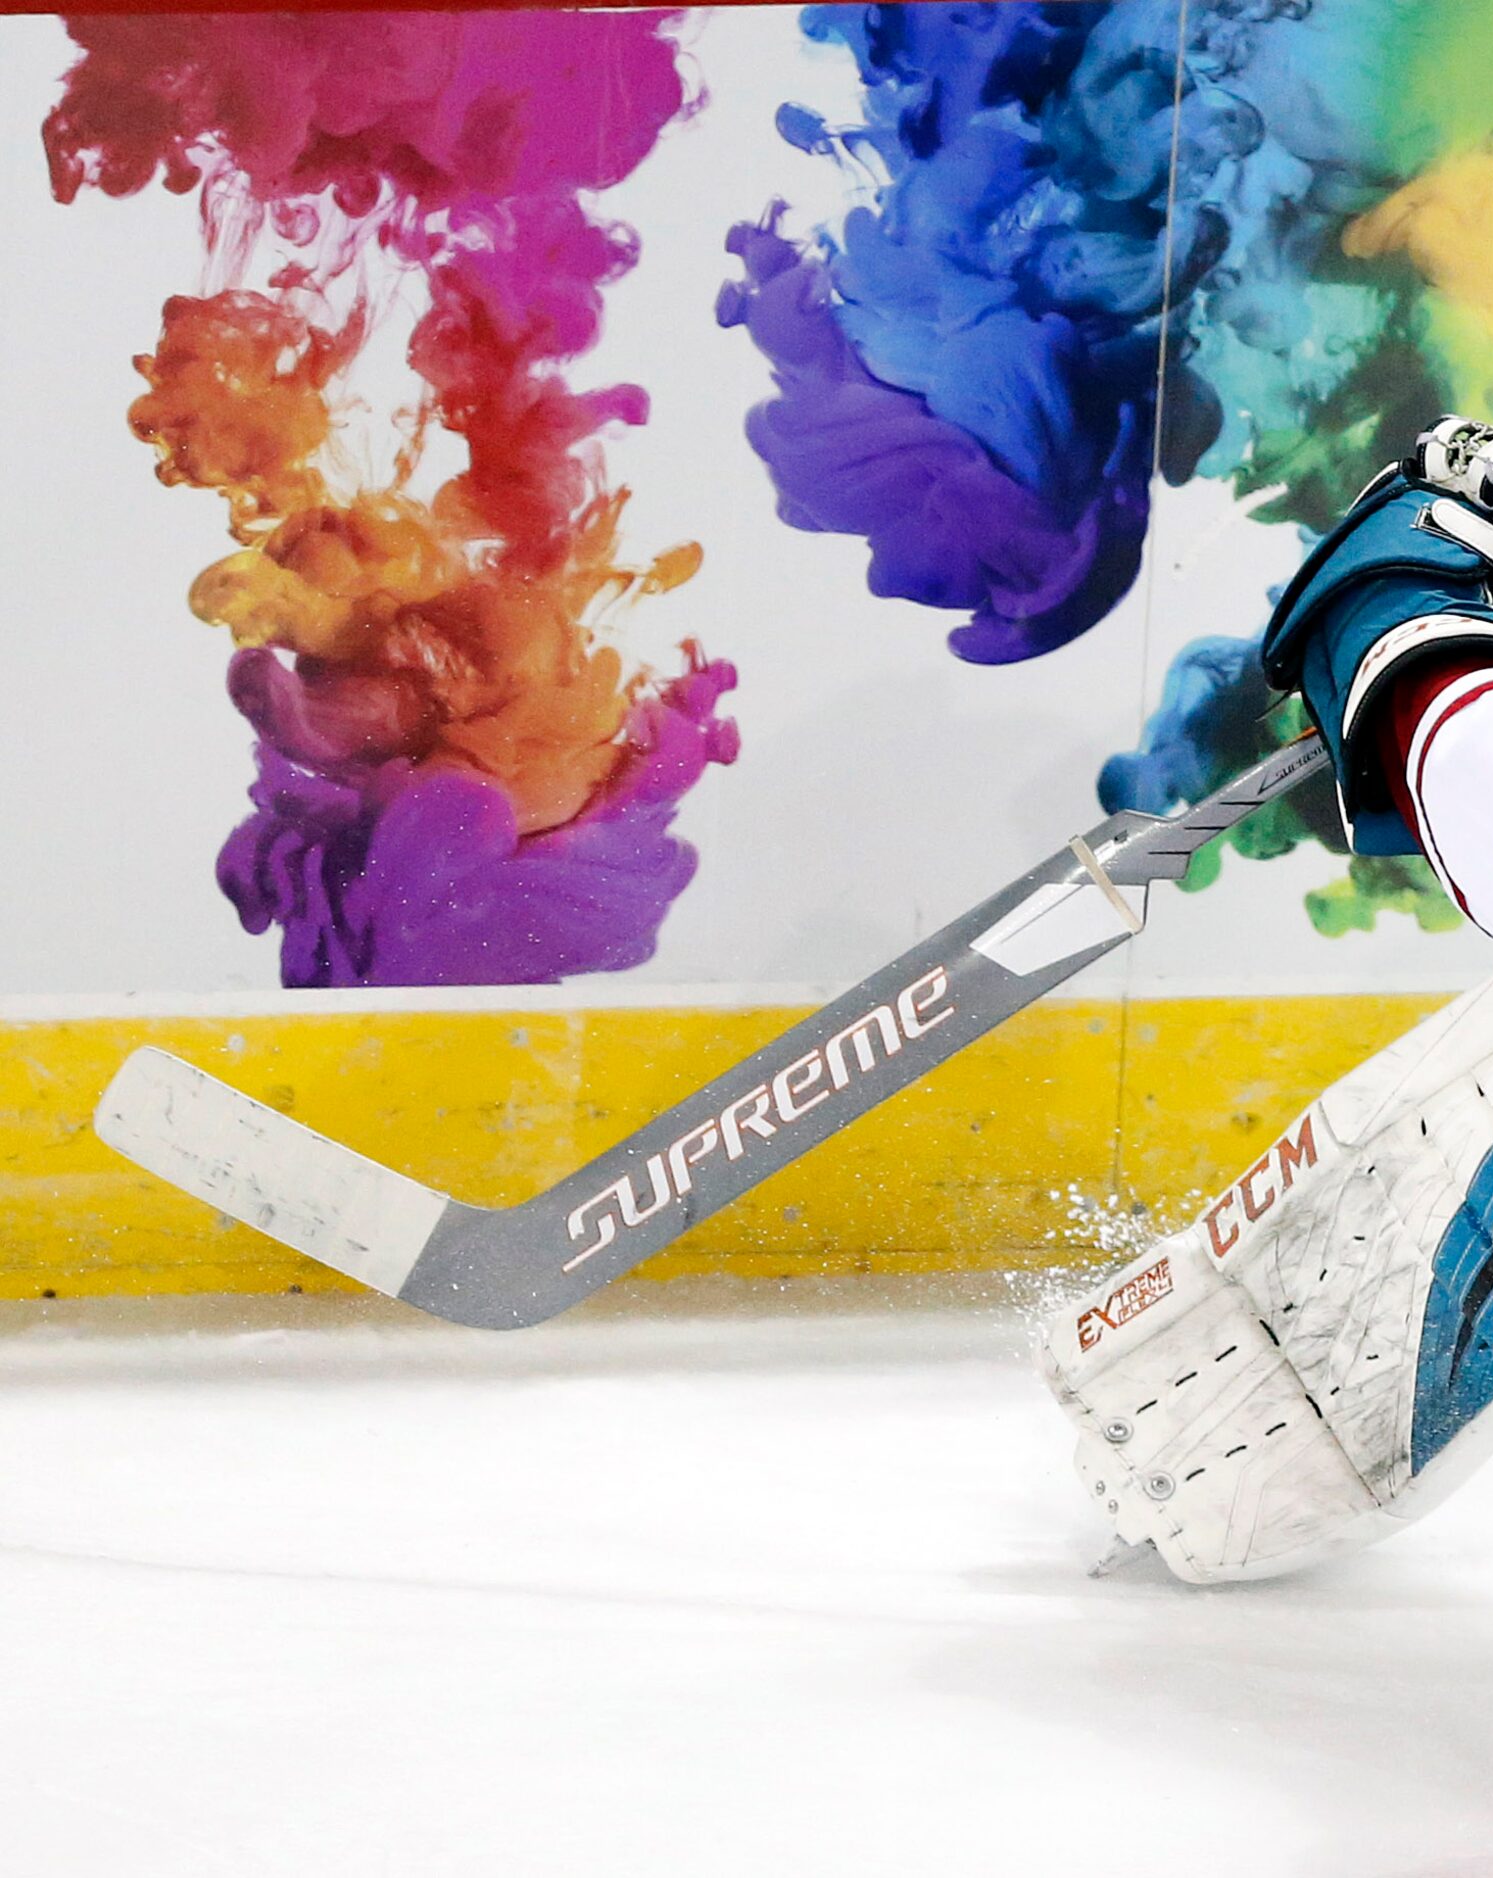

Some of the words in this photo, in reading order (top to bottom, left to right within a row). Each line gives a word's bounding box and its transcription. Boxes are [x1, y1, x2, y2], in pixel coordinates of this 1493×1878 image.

[562, 965, 955, 1274] SUPREME
[1203, 1114, 1319, 1258] CCM
[1077, 1256, 1171, 1353] EXTREME
